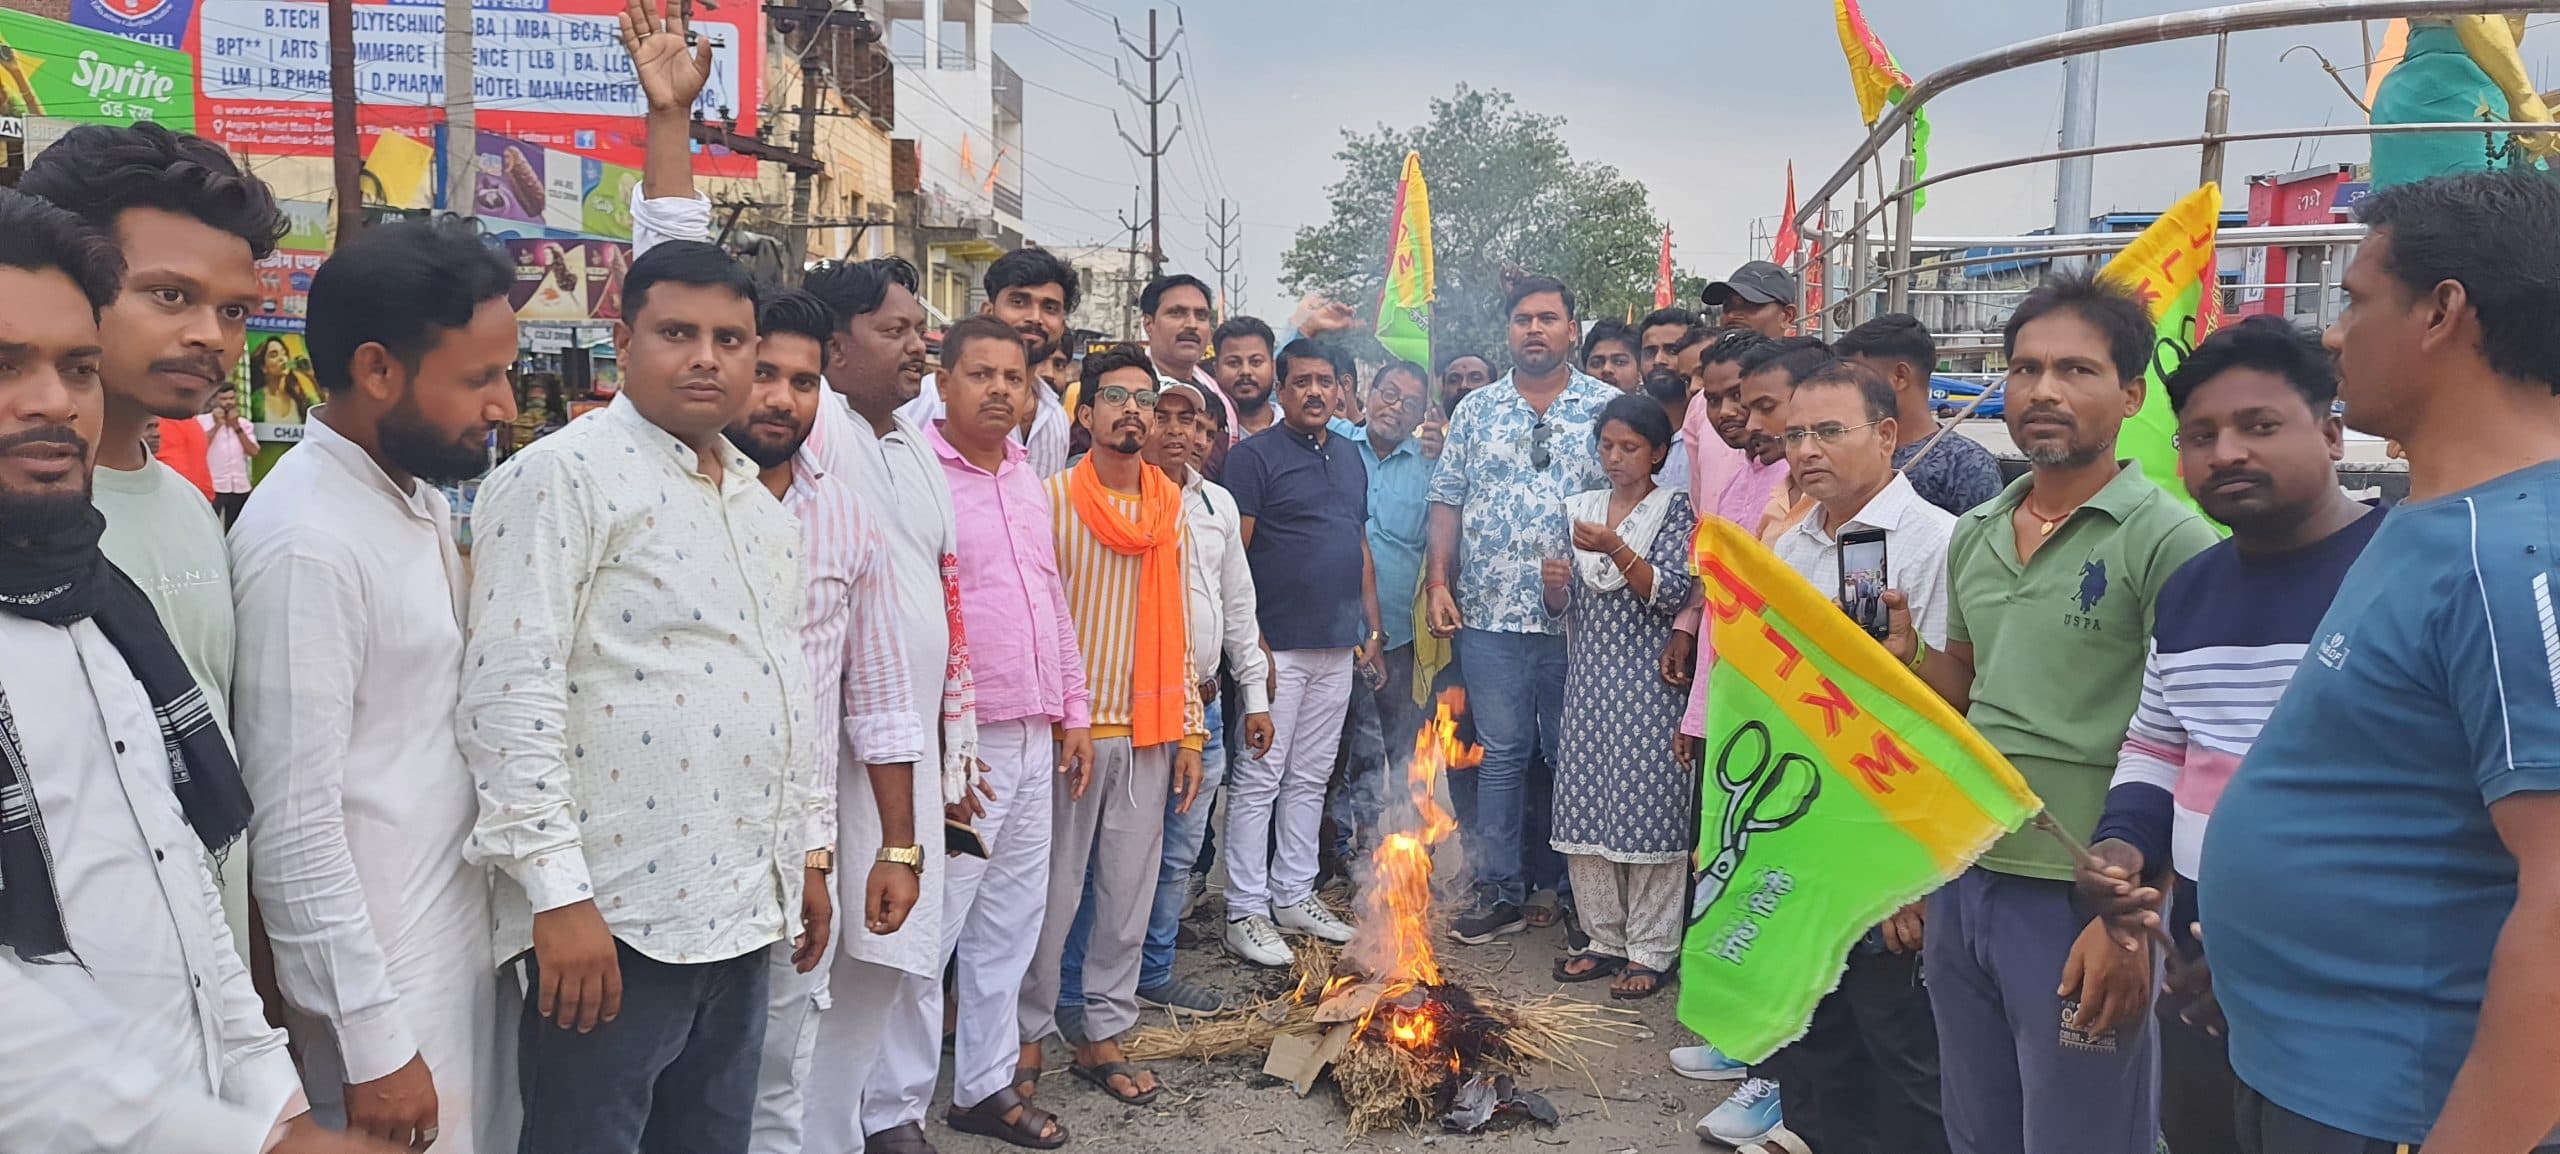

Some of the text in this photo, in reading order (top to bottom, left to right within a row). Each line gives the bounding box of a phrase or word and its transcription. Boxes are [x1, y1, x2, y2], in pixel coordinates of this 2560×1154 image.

[264, 8, 602, 42] B.TECH OLYTECHNIC BA MBA BCA
[280, 40, 318, 59] ARTS
[351, 42, 425, 63] MMERCE
[473, 48, 509, 68] ENCE
[529, 50, 555, 69] LLB
[72, 50, 173, 103] Sprite
[222, 67, 251, 87] LLM
[270, 69, 332, 89] B.PHAR
[372, 73, 444, 94] D.PHARM
[475, 77, 523, 98] HOTEL
[529, 79, 638, 103] MANAGEMENT
[2063, 614, 2101, 631] USPA
